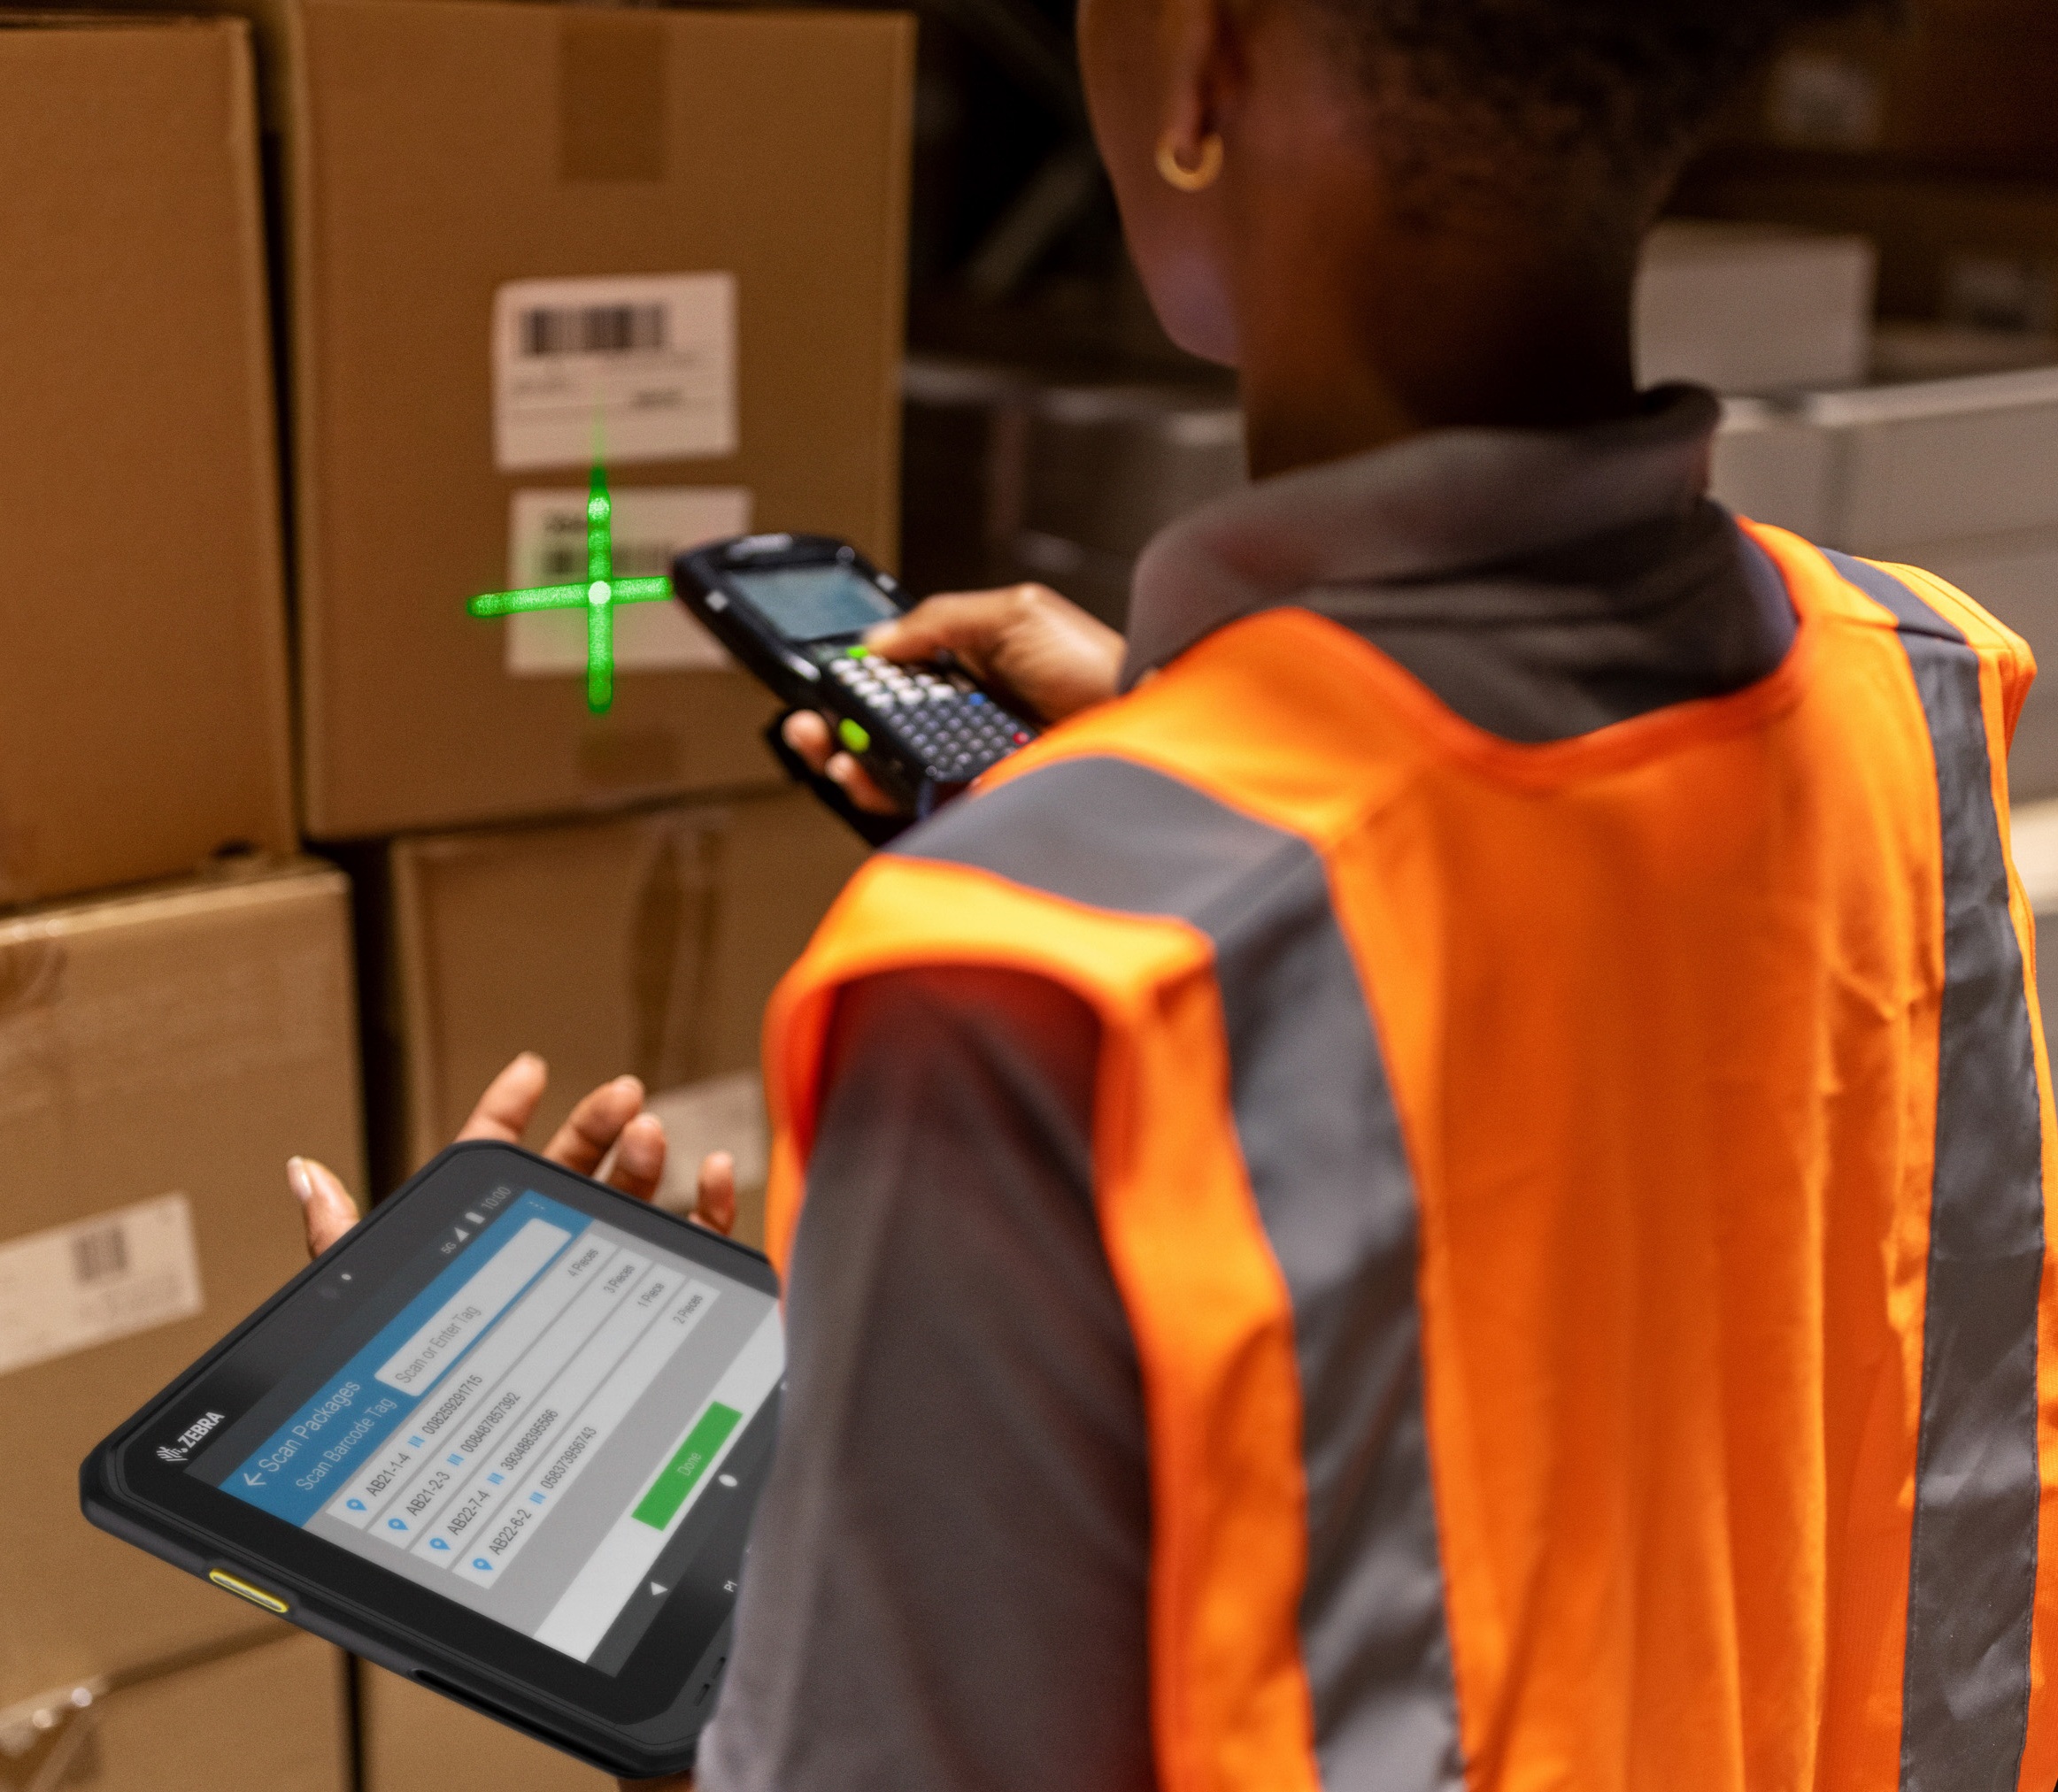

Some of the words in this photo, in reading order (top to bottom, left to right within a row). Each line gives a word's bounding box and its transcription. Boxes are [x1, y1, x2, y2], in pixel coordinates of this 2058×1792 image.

[441, 1242, 457, 1254] 5G
[482, 1186, 512, 1210] 10:00
[572, 1249, 598, 1272] Pieces
[608, 1265, 635, 1287] Pieces
[641, 1282, 665, 1303] Piece
[451, 1306, 482, 1323] Tag
[677, 1295, 703, 1317] Pieces
[429, 1323, 461, 1348] Enter
[422, 1346, 437, 1359] or
[395, 1358, 428, 1383] Scan
[177, 1411, 225, 1450] ZEBRA
[258, 1435, 302, 1472] Scan
[292, 1381, 361, 1440] Packages
[366, 1452, 411, 1496] AB21-1-4
[421, 1374, 482, 1434] 008259291715
[296, 1460, 333, 1490] Scan
[323, 1418, 374, 1463] Barcode
[364, 1397, 397, 1418] Tag
[406, 1471, 450, 1516] AB21-2-3
[460, 1392, 520, 1453] 008487857392
[677, 1452, 702, 1476] Done
[489, 1509, 532, 1555] AB22-6-2
[540, 1427, 597, 1490] 058373956743
[447, 1489, 490, 1535] AB22-7-4
[724, 1580, 737, 1592] P1
